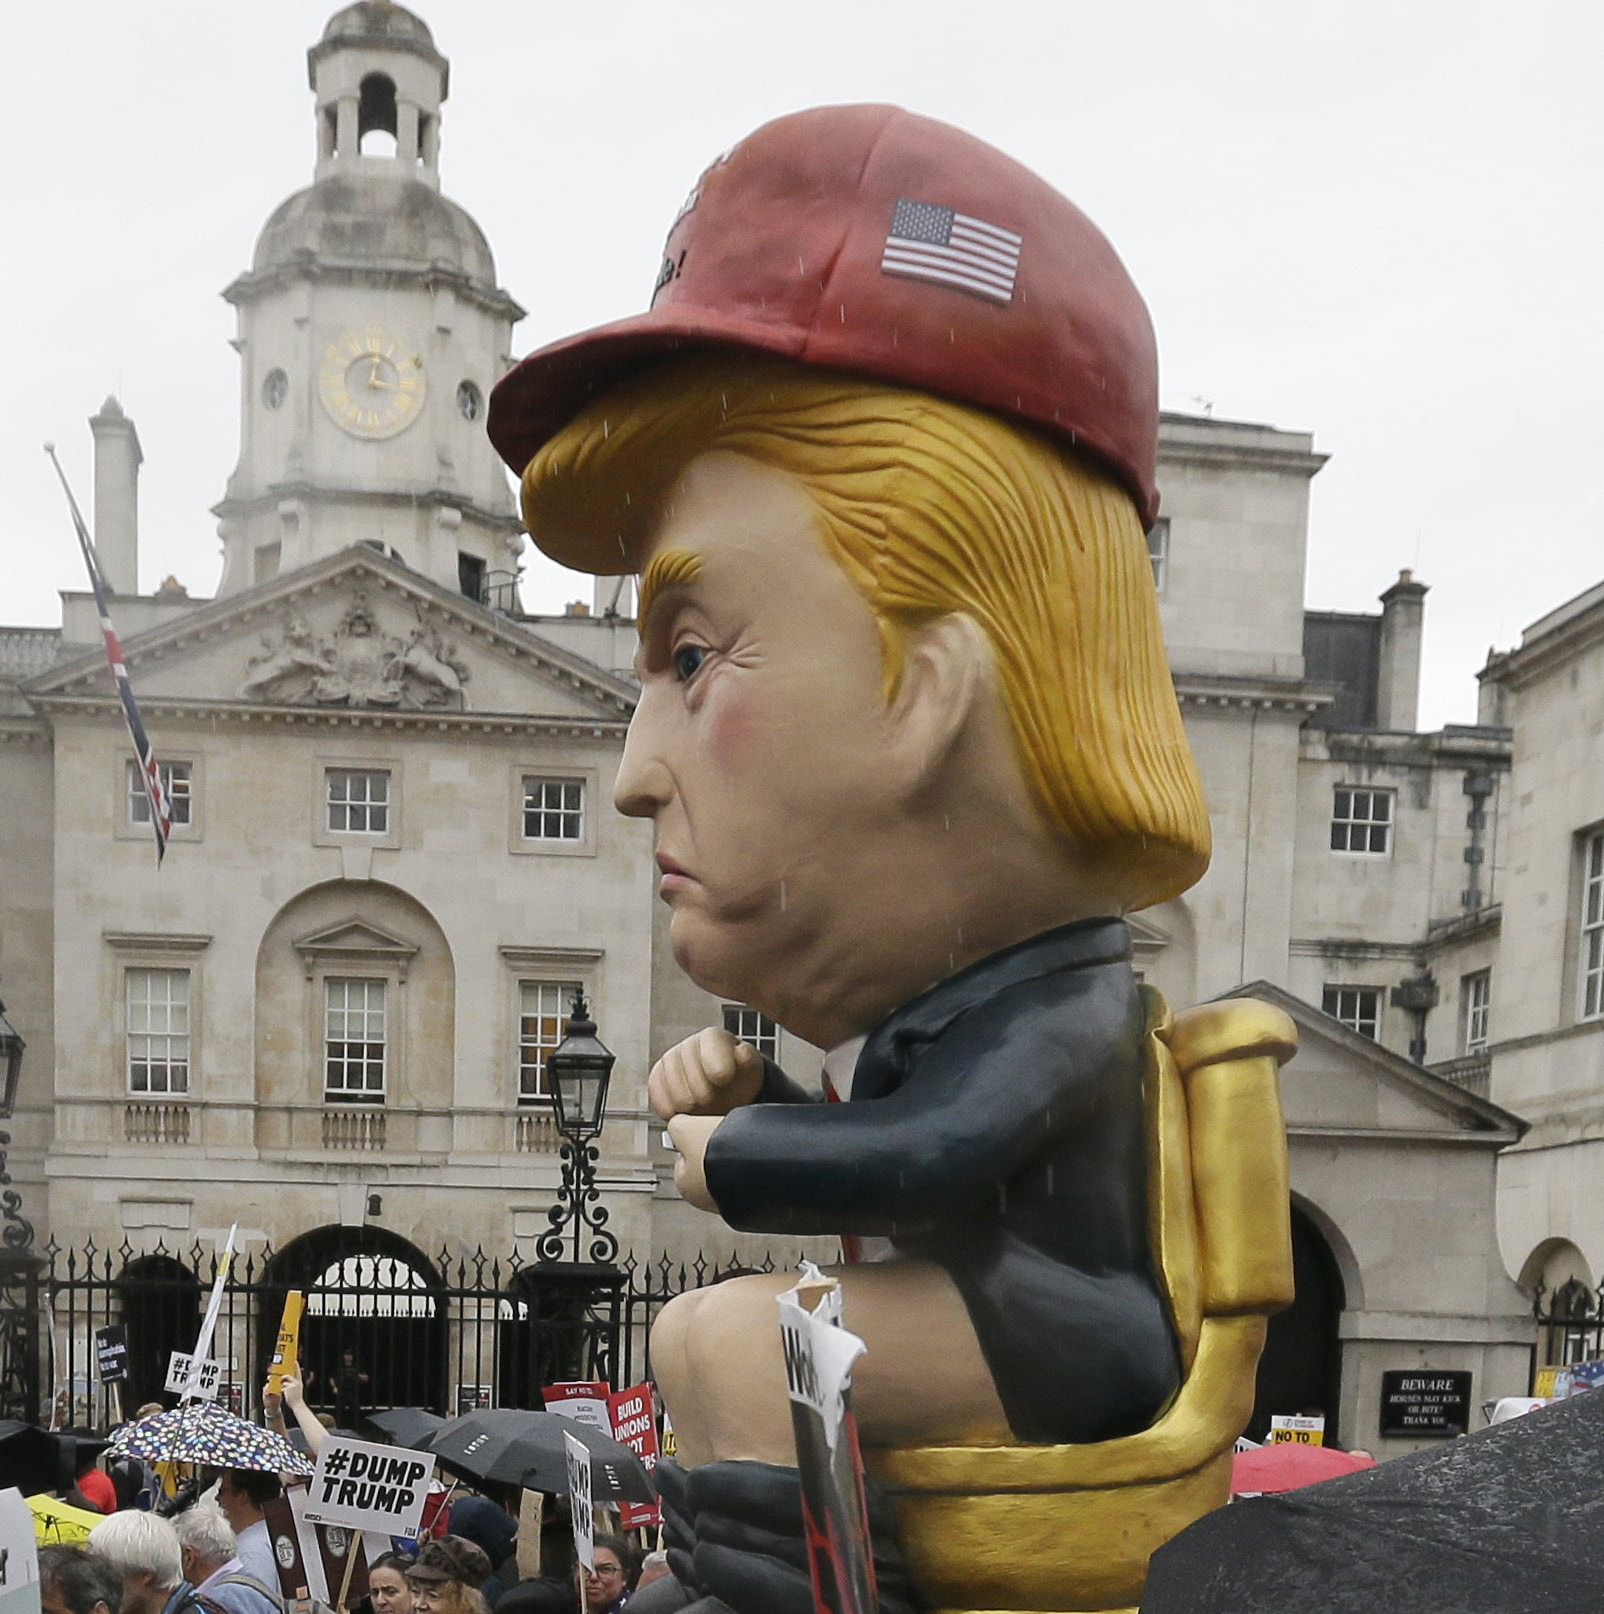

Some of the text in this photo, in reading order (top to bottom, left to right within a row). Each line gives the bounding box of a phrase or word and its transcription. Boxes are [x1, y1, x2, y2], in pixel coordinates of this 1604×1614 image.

[174, 1357, 219, 1378] #DMP
[172, 1370, 214, 1389] TRMP
[1401, 1379, 1454, 1391] BEWARE
[617, 1397, 643, 1421] BUILD
[614, 1414, 651, 1442] UNIONS
[1275, 1430, 1310, 1442] NO TO
[324, 1448, 426, 1488] #DUMP
[322, 1476, 415, 1515] TRUMP
